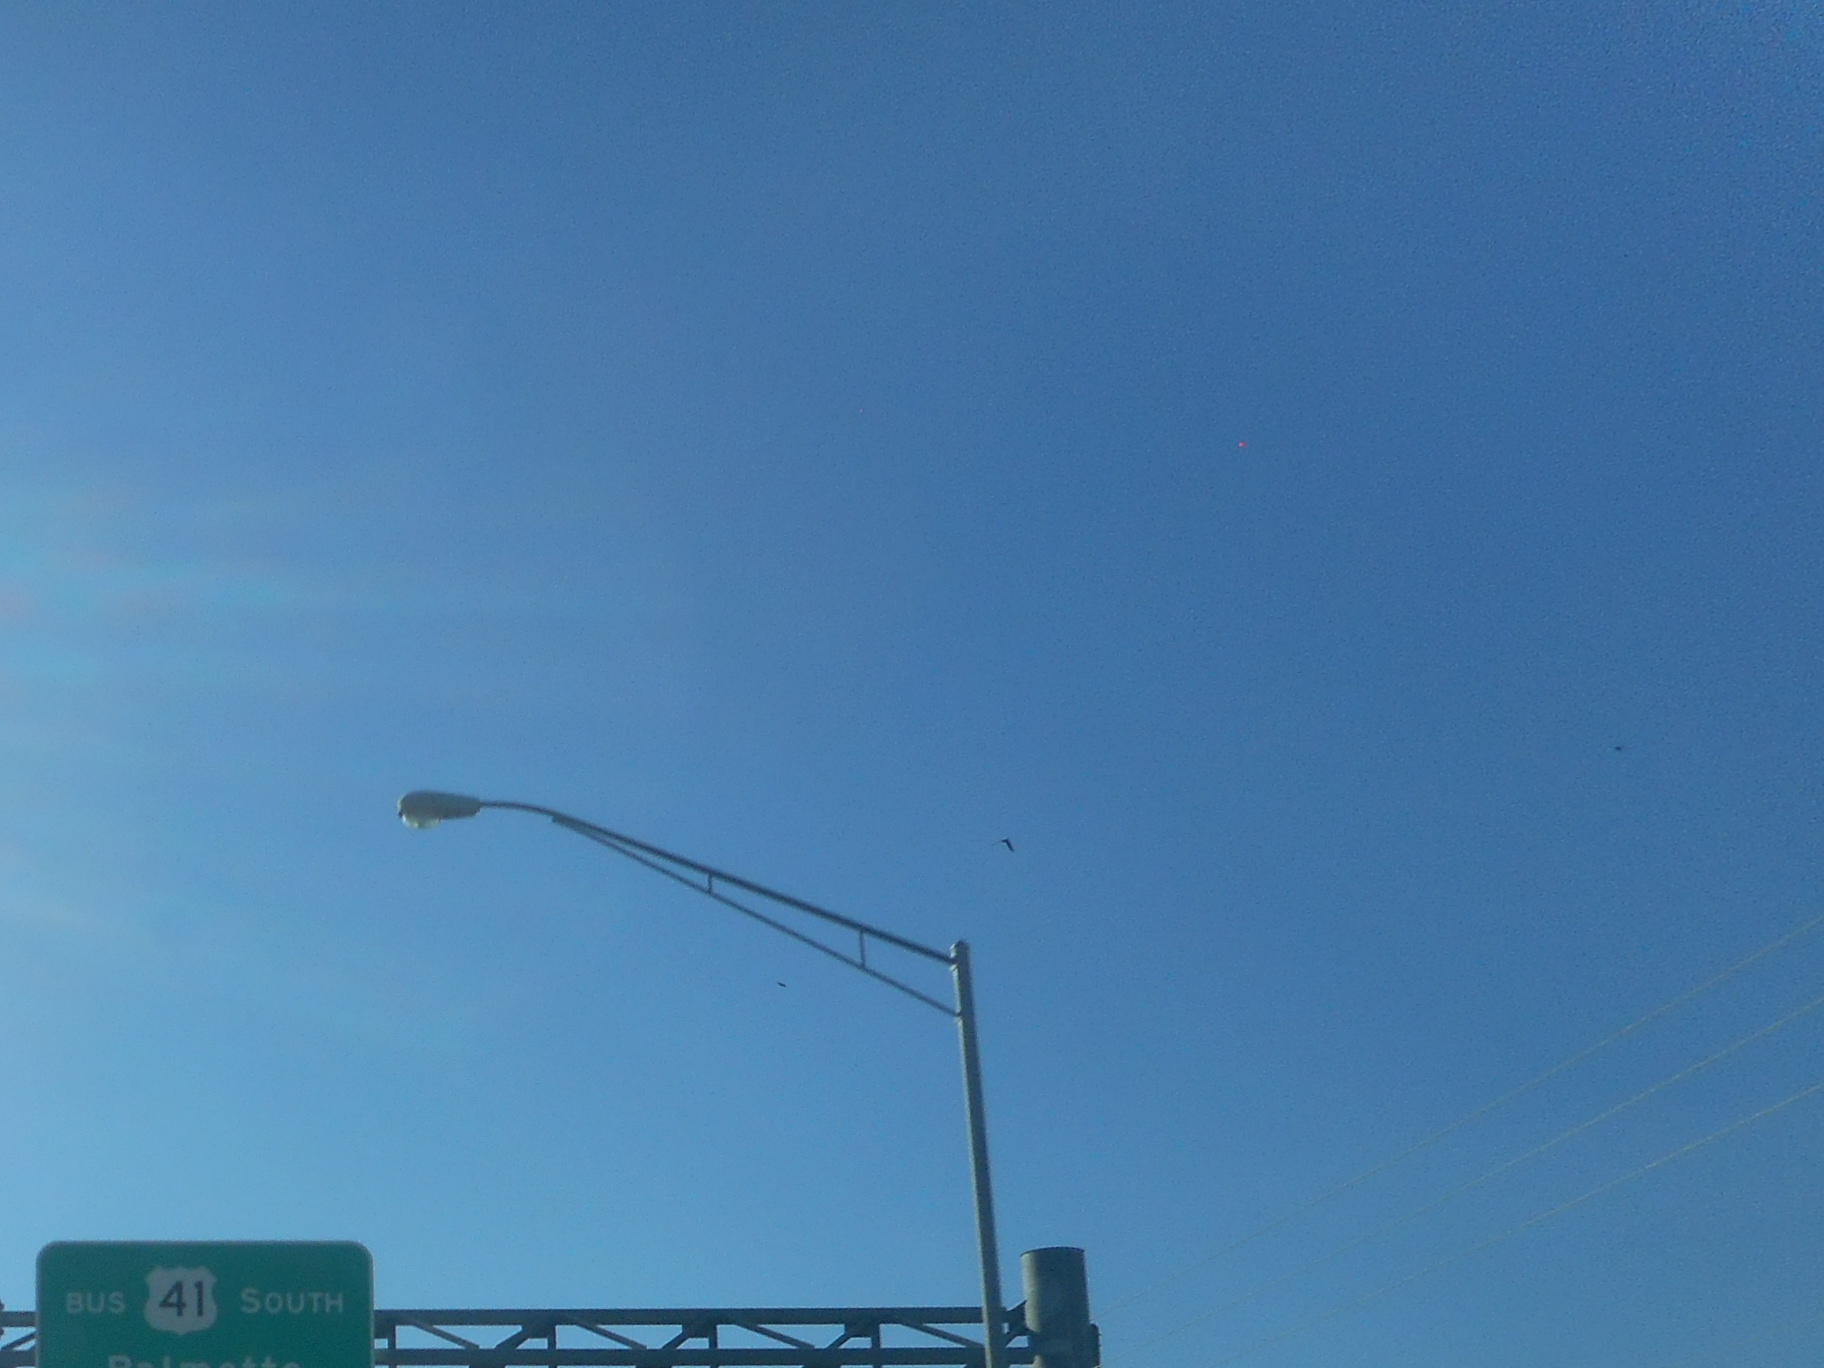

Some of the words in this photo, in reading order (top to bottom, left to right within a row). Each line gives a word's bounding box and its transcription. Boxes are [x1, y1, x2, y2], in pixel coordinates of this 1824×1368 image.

[66, 1291, 125, 1314] BUS
[158, 1280, 205, 1317] 41
[239, 1287, 344, 1315] SOUTH
